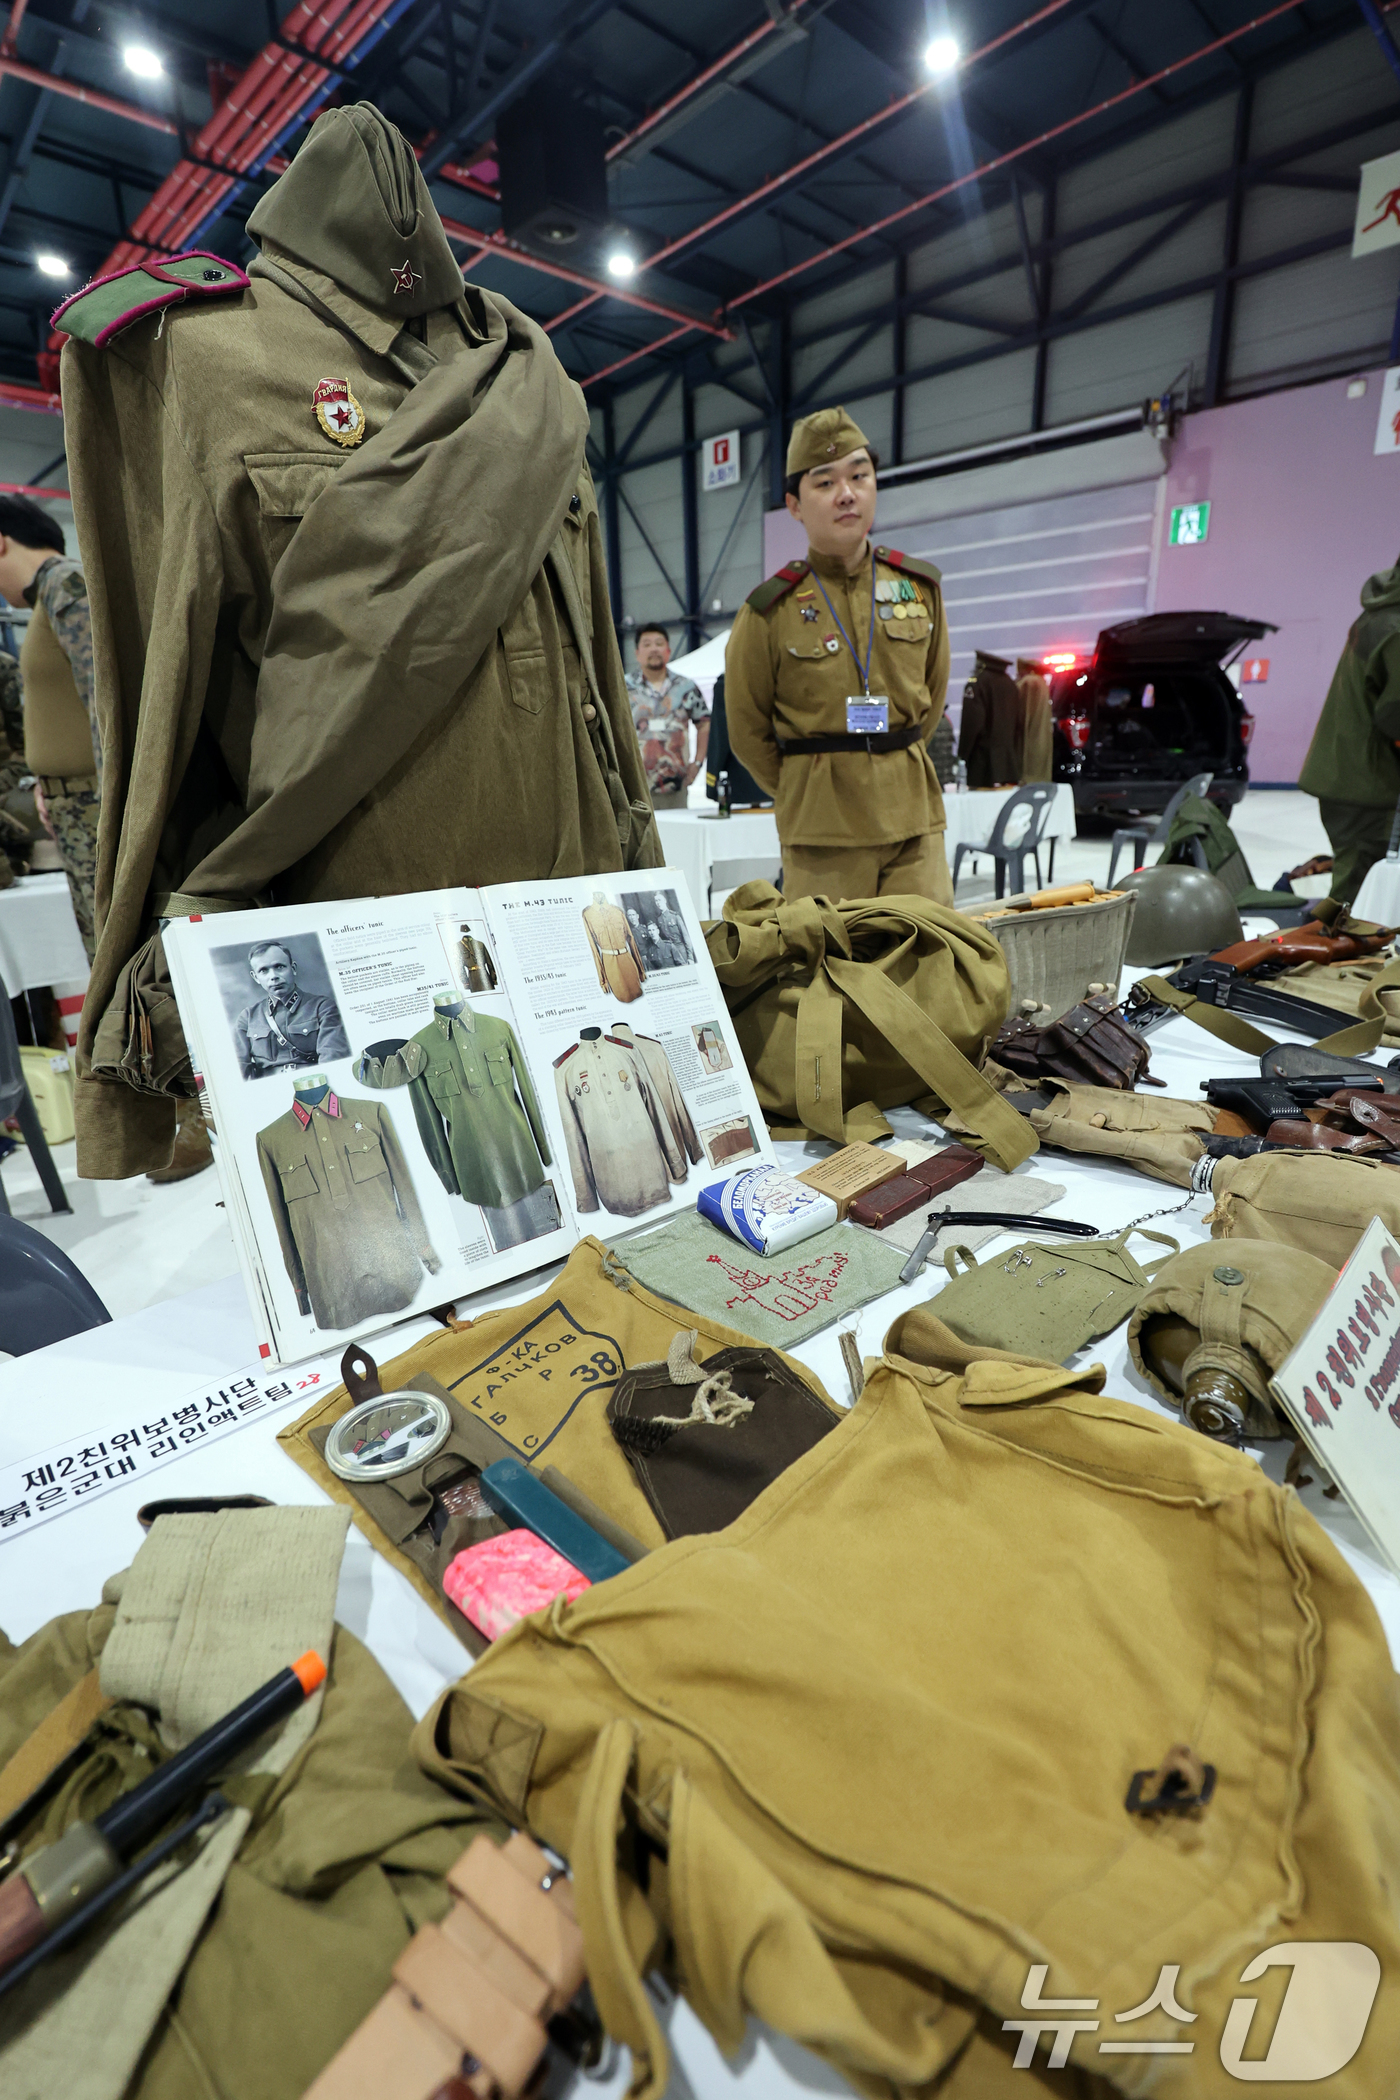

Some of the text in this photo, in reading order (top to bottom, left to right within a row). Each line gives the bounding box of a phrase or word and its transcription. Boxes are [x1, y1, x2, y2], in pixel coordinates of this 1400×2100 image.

[318, 384, 347, 398] ГВАРДИЯ
[327, 927, 339, 936] The
[352, 965, 377, 974] OFFICER'S
[732, 1164, 774, 1210] БЕЛОМОРКАНАЛ
[296, 1373, 321, 1389] 28
[22, 1377, 258, 1492] 제2친위보병사단
[0, 1381, 293, 1528] 붉은군대 리인액트팀
